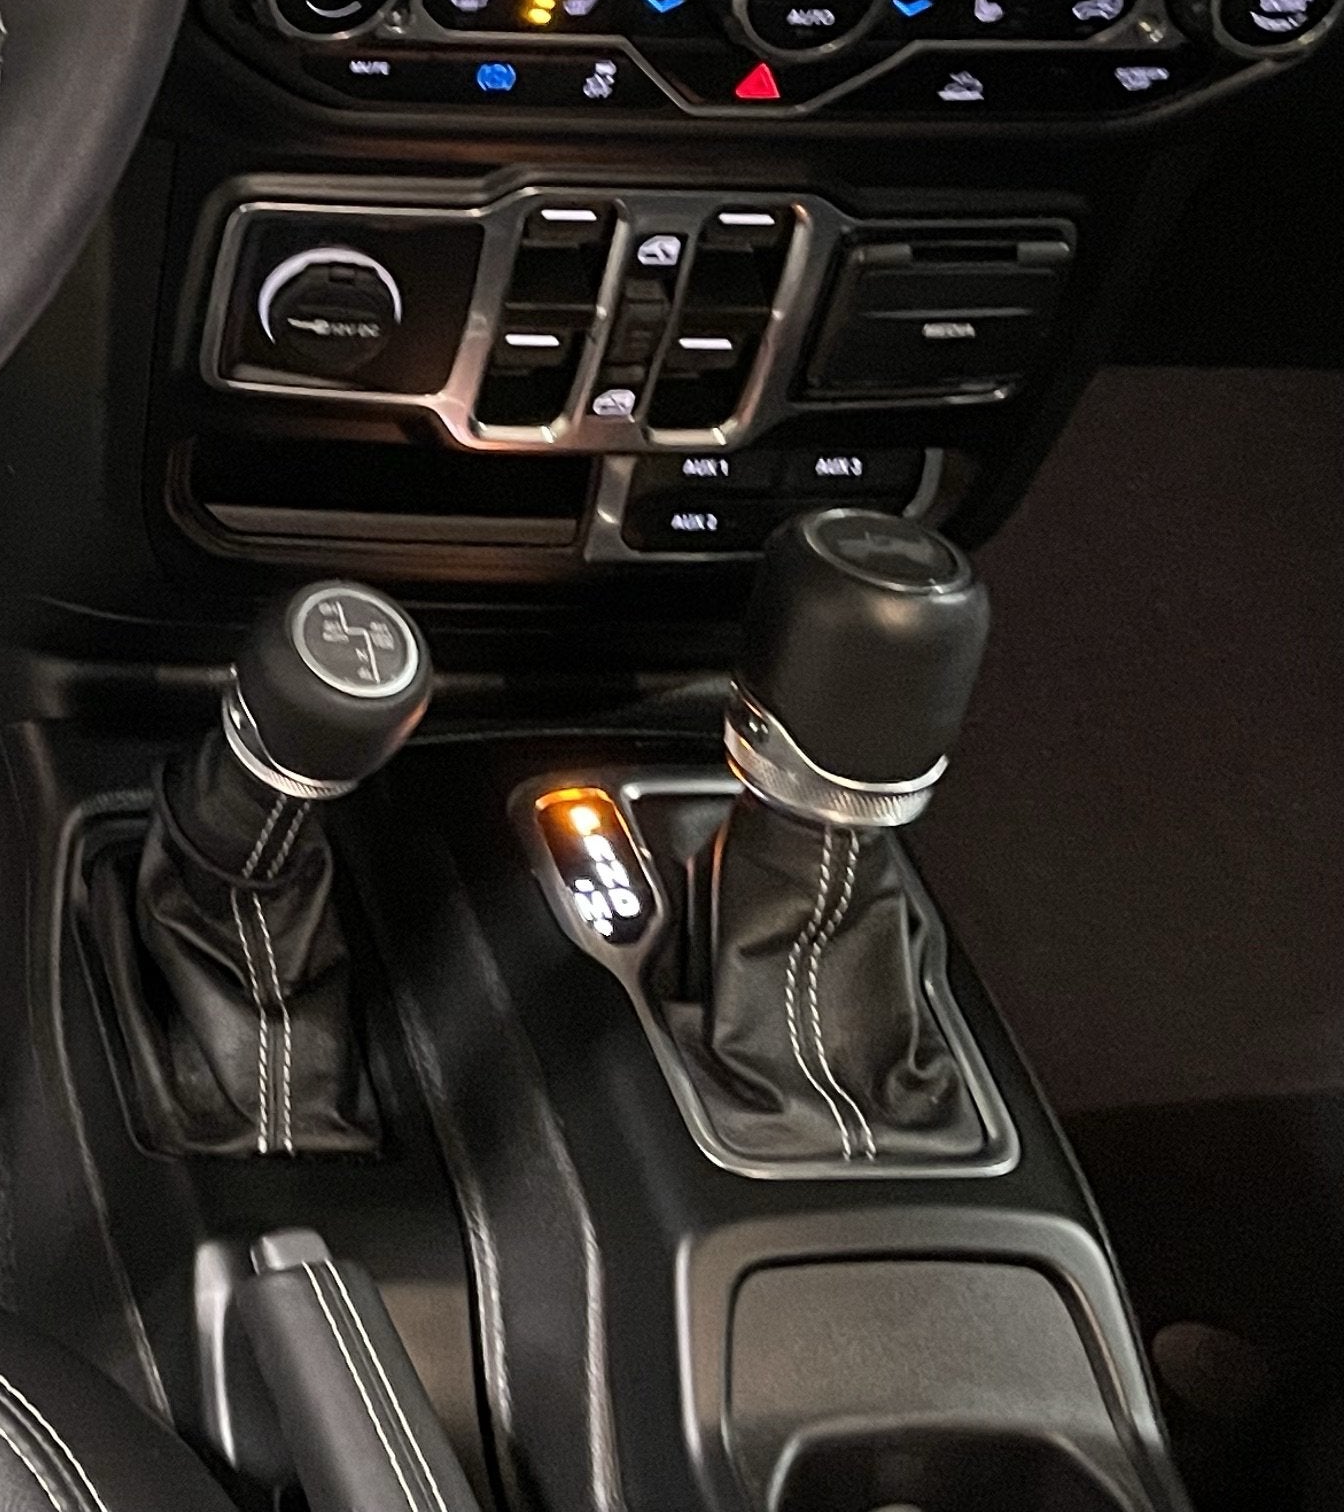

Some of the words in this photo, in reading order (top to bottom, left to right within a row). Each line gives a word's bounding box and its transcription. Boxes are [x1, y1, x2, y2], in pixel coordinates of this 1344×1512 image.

[682, 457, 720, 477] AUX
[814, 456, 850, 477] AUX
[670, 513, 705, 532] AUX
[595, 859, 630, 889] N
[573, 891, 613, 923] M
[607, 888, 641, 917] D
